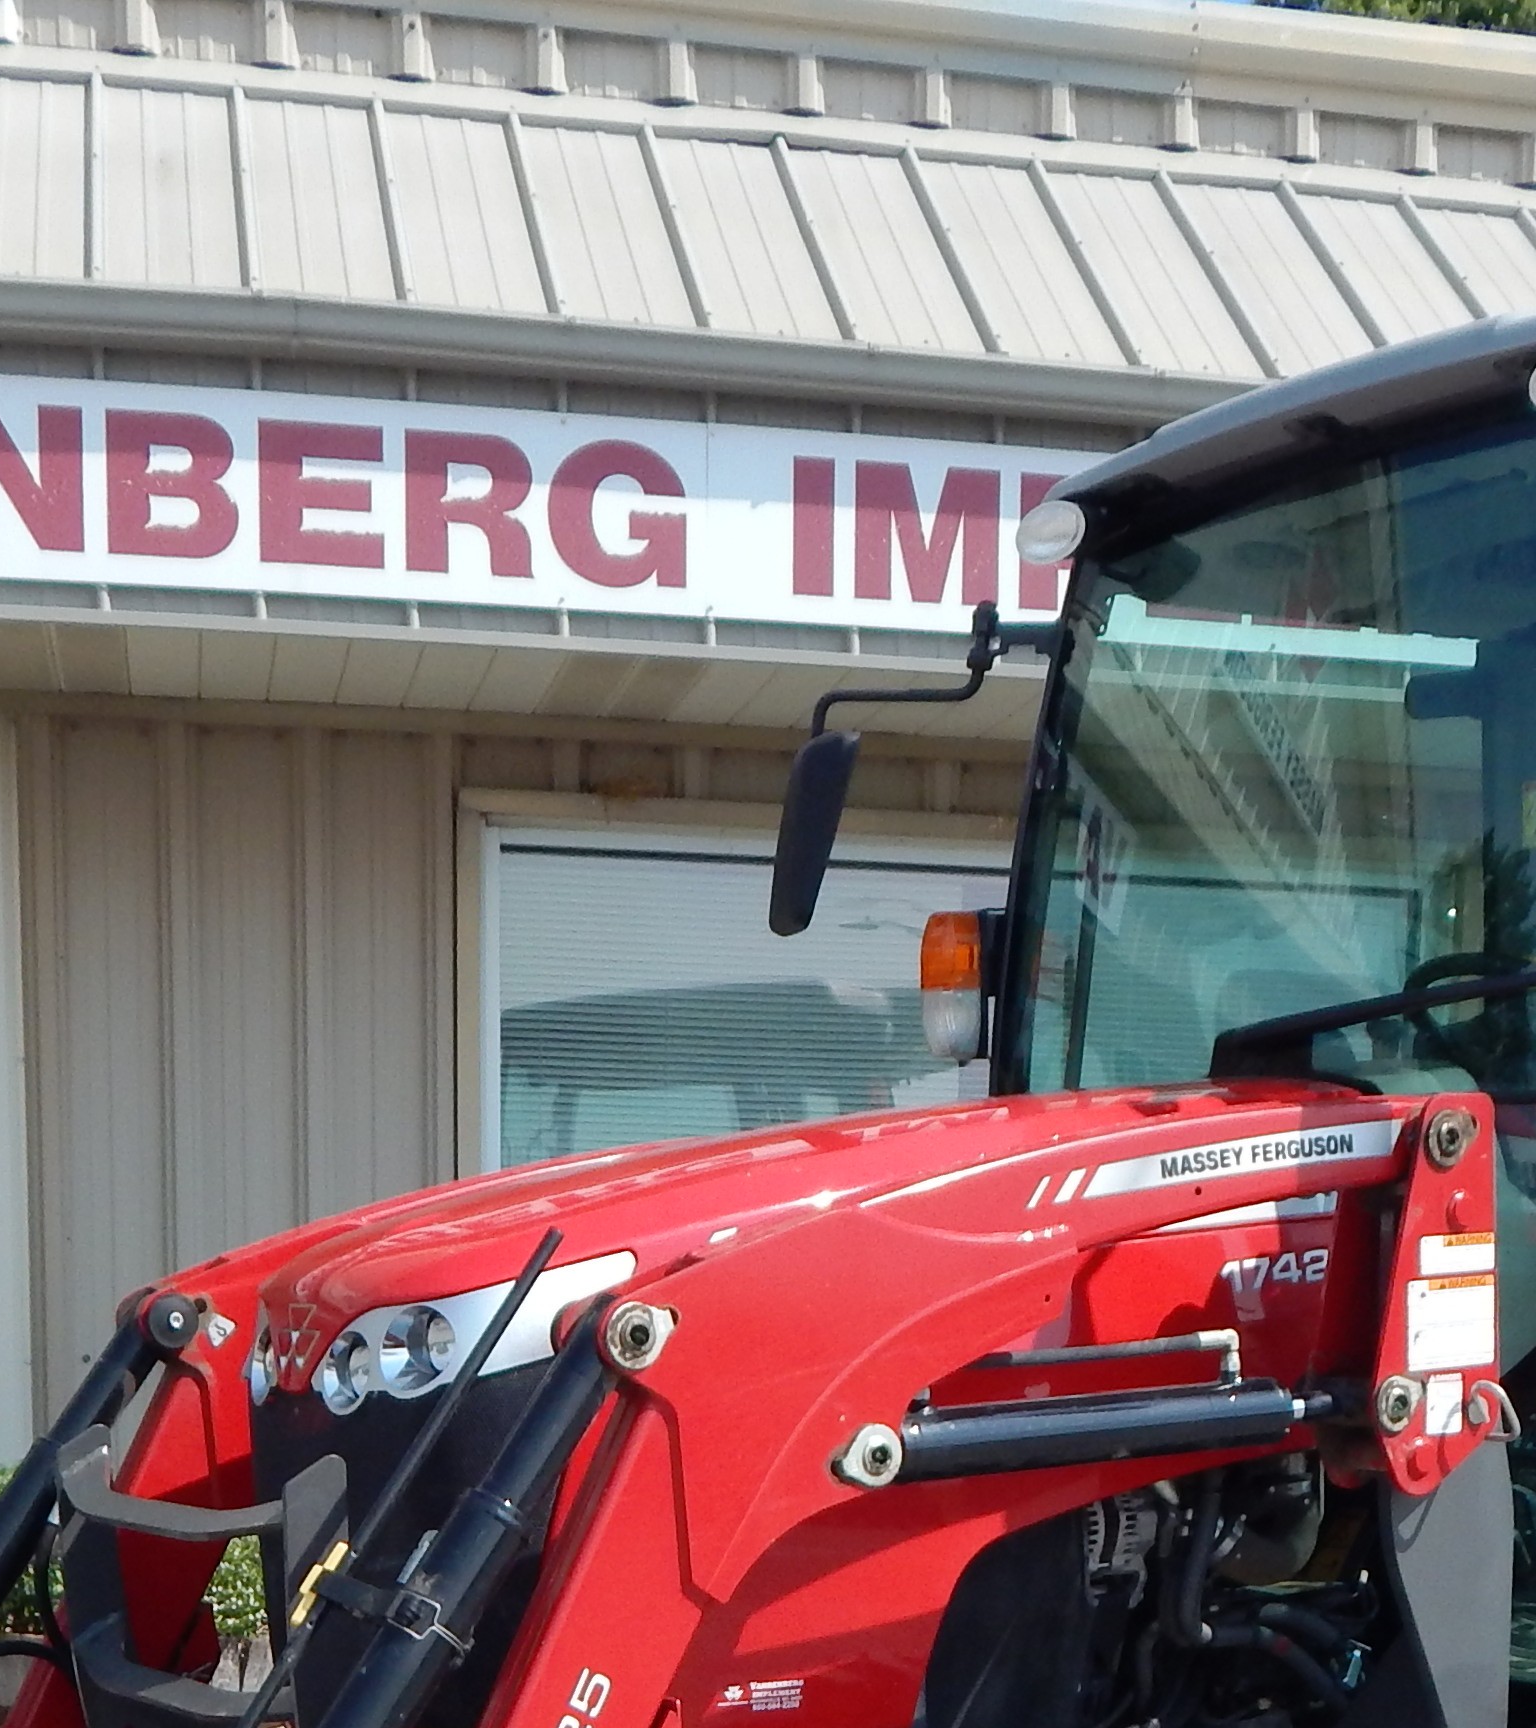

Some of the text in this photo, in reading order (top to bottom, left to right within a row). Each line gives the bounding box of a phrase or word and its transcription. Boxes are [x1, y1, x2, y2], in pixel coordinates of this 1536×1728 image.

[1160, 1133, 1354, 1179] MASSEY FERGUSON
[1219, 1249, 1329, 1294] 1742
